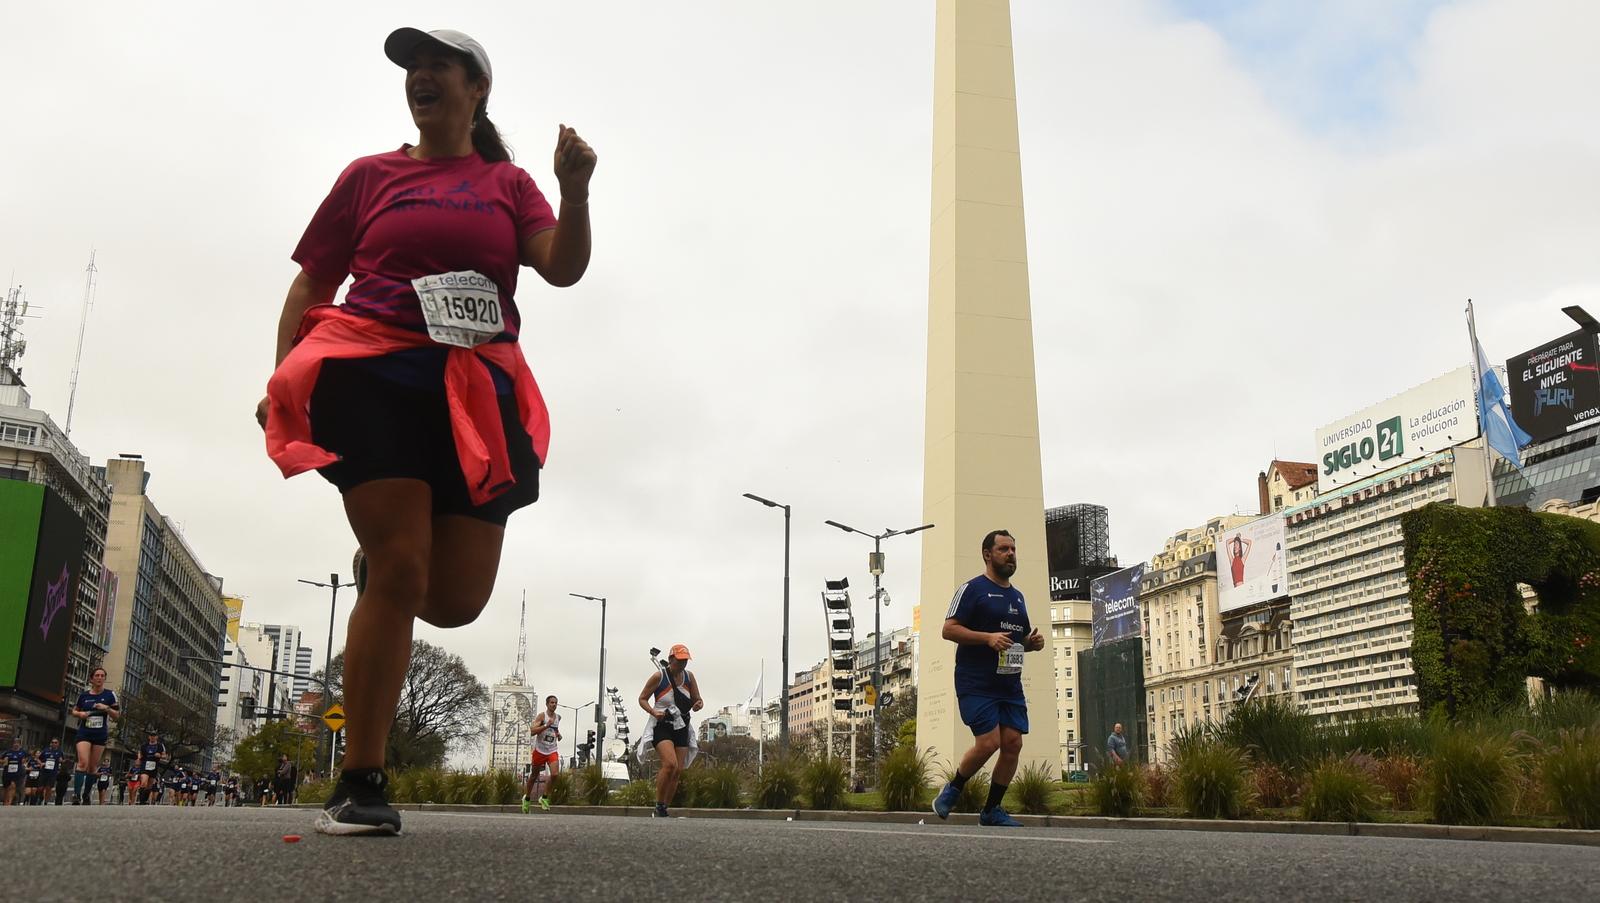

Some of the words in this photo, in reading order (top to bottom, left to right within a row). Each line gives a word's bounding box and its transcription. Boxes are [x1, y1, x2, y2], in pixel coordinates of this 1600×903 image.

[438, 274, 496, 290] telecom
[442, 295, 498, 325] 15920
[1558, 341, 1575, 354] PARA
[1522, 369, 1534, 382] EL
[1535, 348, 1583, 376] SIGUIENTE
[1540, 371, 1568, 390] NIVEL
[1409, 417, 1421, 429] La
[1421, 398, 1466, 427] educación
[1323, 418, 1373, 447] UNIVERSIDAD
[1411, 415, 1459, 442] evoluciona
[1323, 436, 1375, 476] SIGLO
[1379, 427, 1399, 456] 21
[1050, 576, 1080, 592] Benz
[1105, 595, 1135, 614] telecom
